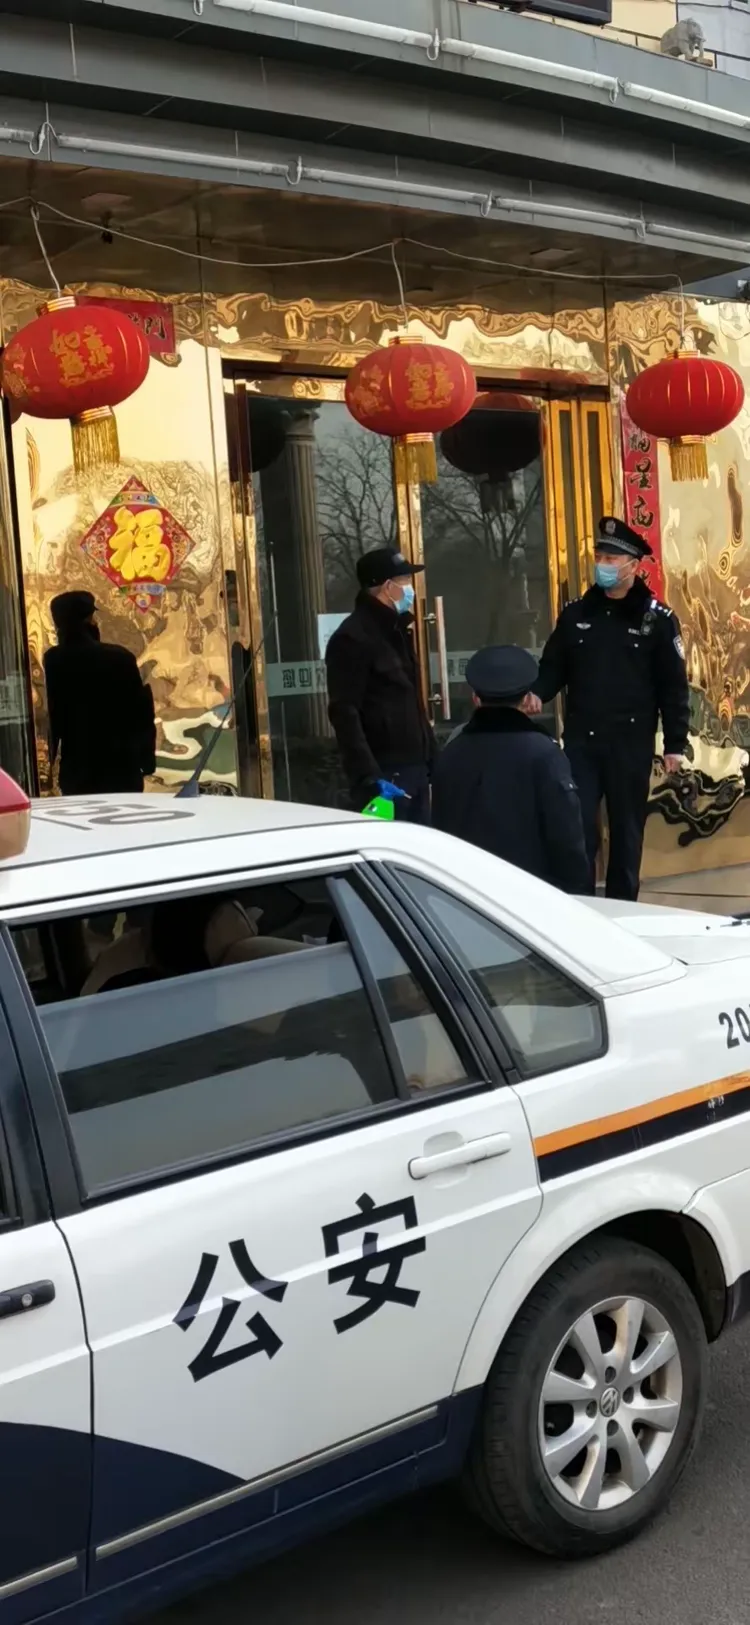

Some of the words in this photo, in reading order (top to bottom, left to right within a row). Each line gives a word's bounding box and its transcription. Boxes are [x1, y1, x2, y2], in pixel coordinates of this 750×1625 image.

[108, 505, 171, 582] 福
[718, 1003, 750, 1050] 20
[173, 1193, 427, 1383] 公安
